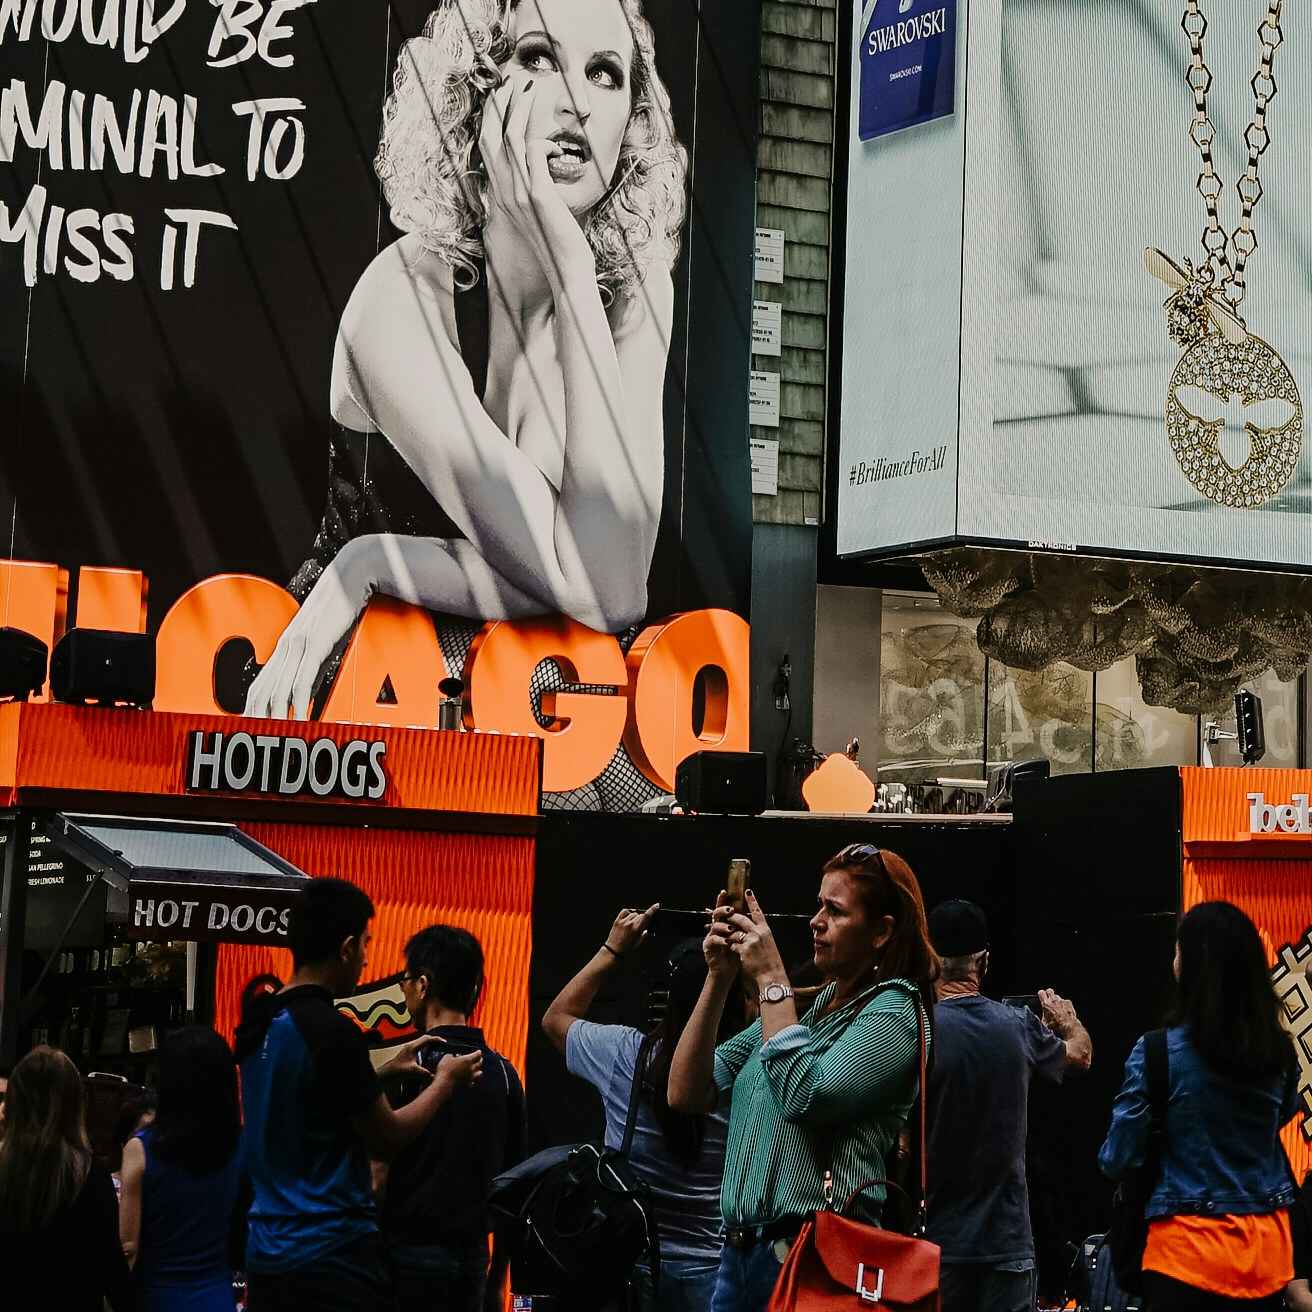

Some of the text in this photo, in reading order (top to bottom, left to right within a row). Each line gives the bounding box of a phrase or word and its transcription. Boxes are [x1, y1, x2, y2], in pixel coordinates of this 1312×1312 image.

[868, 7, 946, 56] SWAROVSKI
[0, 78, 307, 182] MINAL TO
[160, 208, 239, 290] IT
[848, 447, 947, 487] #BrillianceForAll
[134, 899, 291, 936] HOT DOGS
